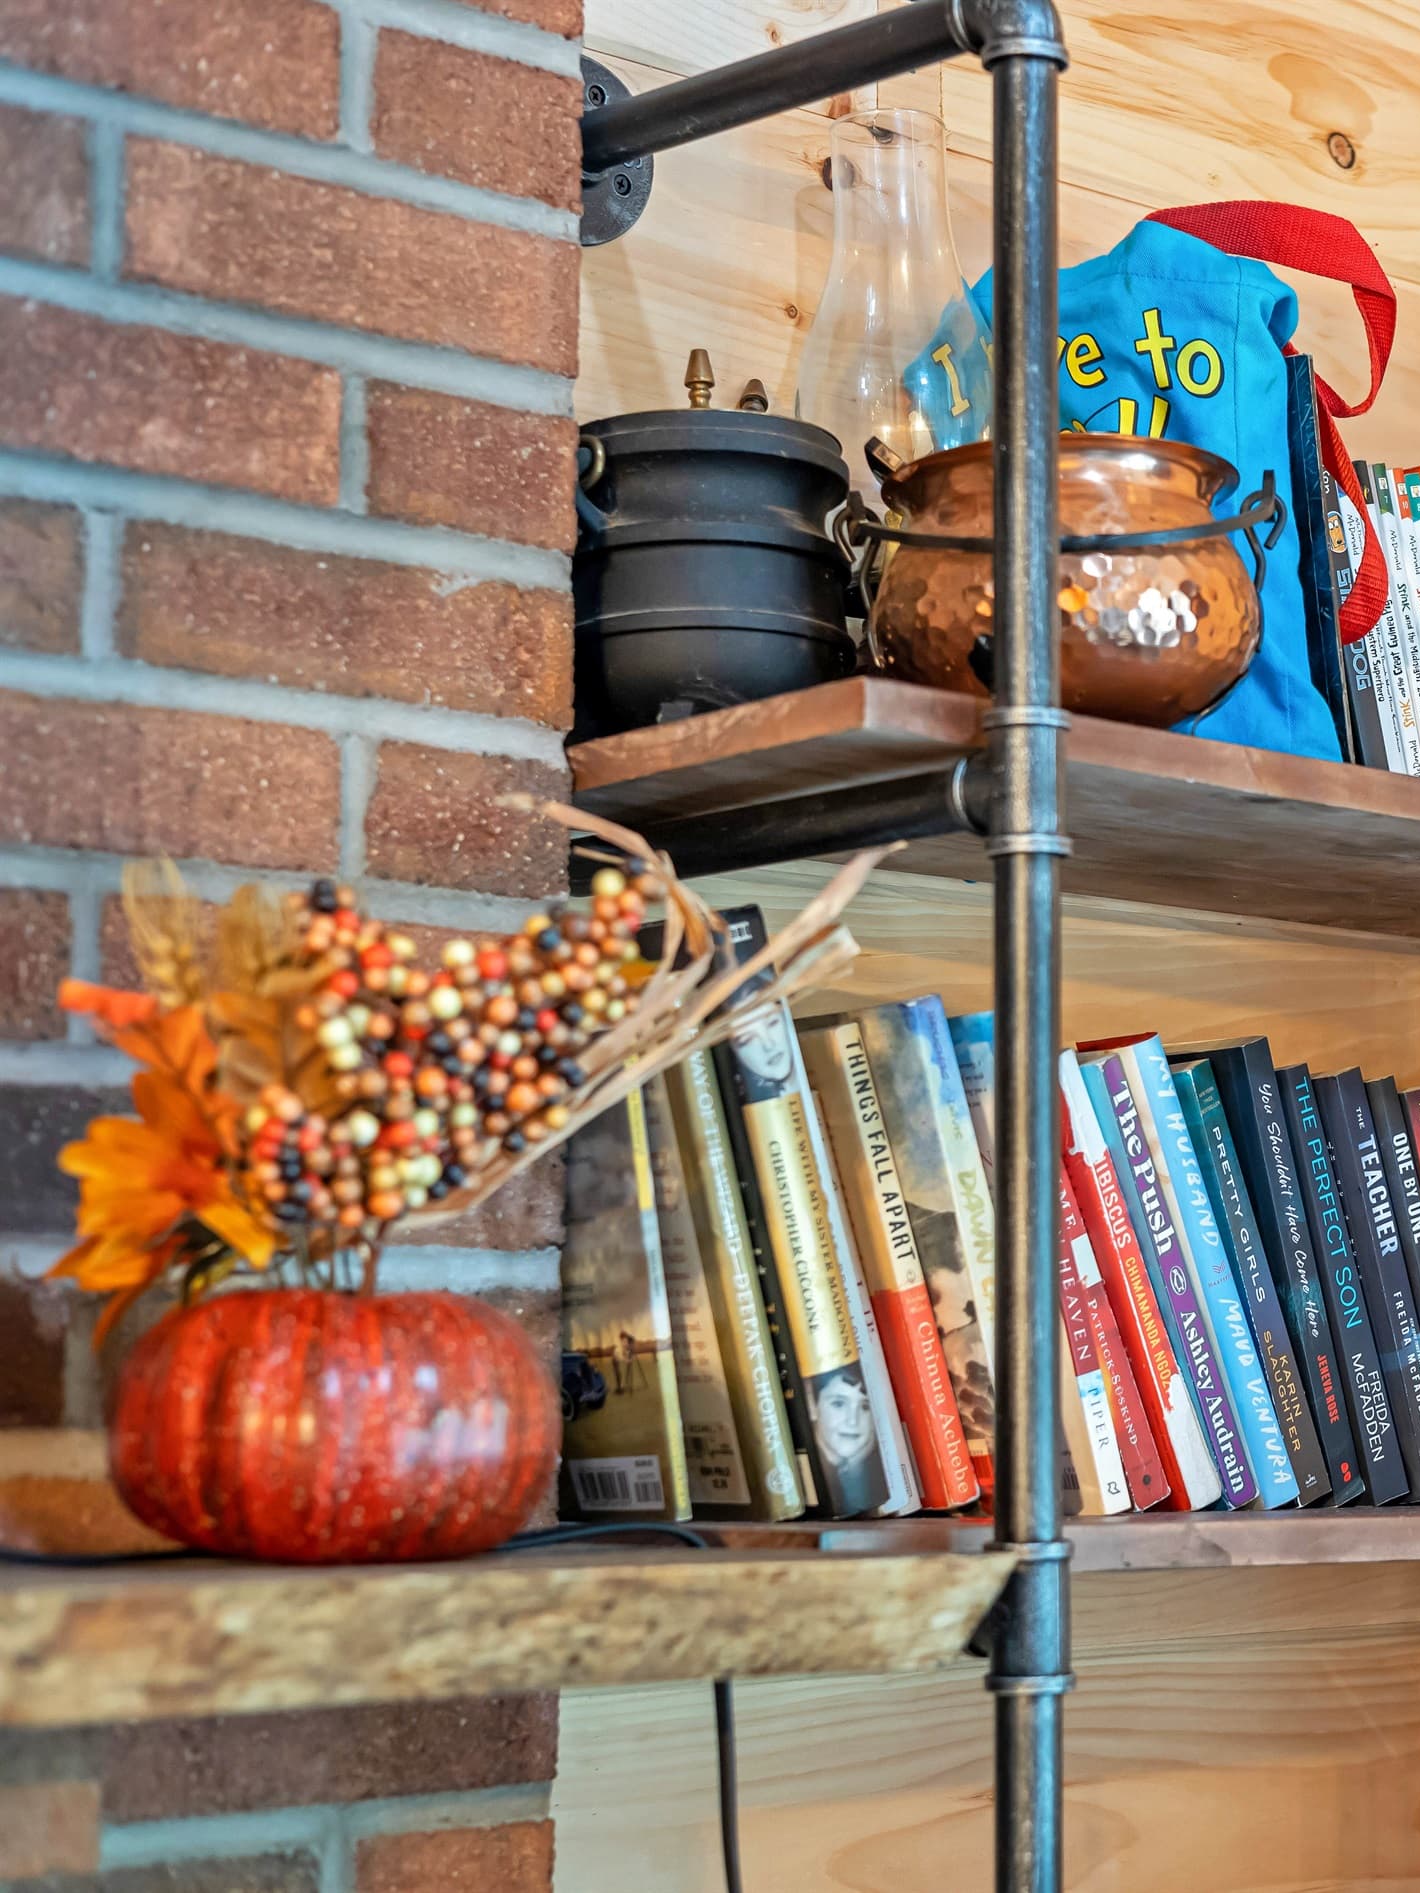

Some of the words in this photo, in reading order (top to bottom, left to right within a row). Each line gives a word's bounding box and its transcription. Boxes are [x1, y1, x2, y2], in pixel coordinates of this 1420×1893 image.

[1135, 308, 1224, 398] to
[1390, 530, 1402, 570] McDonald
[1387, 614, 1399, 648] Guinea
[1397, 584, 1411, 612] Stink
[1404, 614, 1414, 630] and
[1390, 651, 1403, 676] Great
[1408, 632, 1416, 644] the
[1372, 660, 1385, 702] Superhero
[1399, 700, 1416, 728] Stink
[698, 1092, 716, 1120] OF
[788, 1101, 803, 1136] LIFE
[1355, 1106, 1366, 1130] THE
[798, 1140, 817, 1180] WITH
[846, 1037, 880, 1124] THINGS
[867, 1130, 894, 1185] FALL
[882, 1191, 917, 1261] APART
[1113, 1080, 1143, 1158] The
[1134, 1158, 1176, 1257] Push
[1149, 1055, 1177, 1098] MY
[1166, 1112, 1221, 1248] HUSBAND
[1392, 1132, 1415, 1175] ONE
[810, 1190, 824, 1213] MY
[1212, 1125, 1244, 1218] PRETTY
[1240, 1226, 1266, 1304] GIRLS
[1295, 1076, 1318, 1133] THE
[1307, 1138, 1348, 1258] PERFECT
[1334, 1266, 1363, 1330] SON
[1358, 1134, 1399, 1257] TEACHER
[1403, 1176, 1419, 1198] BY
[768, 1140, 803, 1257] CHRISTOPHER
[795, 1259, 820, 1336] CICCONE
[816, 1216, 836, 1273] SISTER
[1283, 1204, 1301, 1244] Have
[1294, 1250, 1310, 1294] Come
[1304, 1300, 1320, 1339] Here
[826, 1273, 852, 1358] MADONNA
[1058, 1258, 1092, 1361] HEAVEN
[1088, 1298, 1114, 1369] PATRICK
[1125, 1256, 1162, 1349] CHIMAMANDA
[1154, 1350, 1172, 1390] NGOZ
[1392, 1290, 1412, 1347] FREIDA
[733, 1275, 764, 1360] DEEPAK
[753, 1366, 783, 1453] CHOPRA
[1218, 1297, 1254, 1367] MAUD
[1246, 1377, 1292, 1484] VENTURA
[1264, 1330, 1301, 1452] SLAUGHTER
[1279, 1354, 1303, 1417] KARIN
[1316, 1354, 1333, 1394] JENEVA
[1326, 1394, 1341, 1424] ROSE
[917, 1320, 947, 1407] Chinua
[939, 1412, 970, 1495] Achebe
[1088, 1387, 1110, 1448] PIPER
[1181, 1310, 1214, 1391] Ashley
[1206, 1395, 1246, 1494] Audrain
[1352, 1352, 1385, 1463] McFADDEN
[1368, 1370, 1391, 1435] FREIDA
